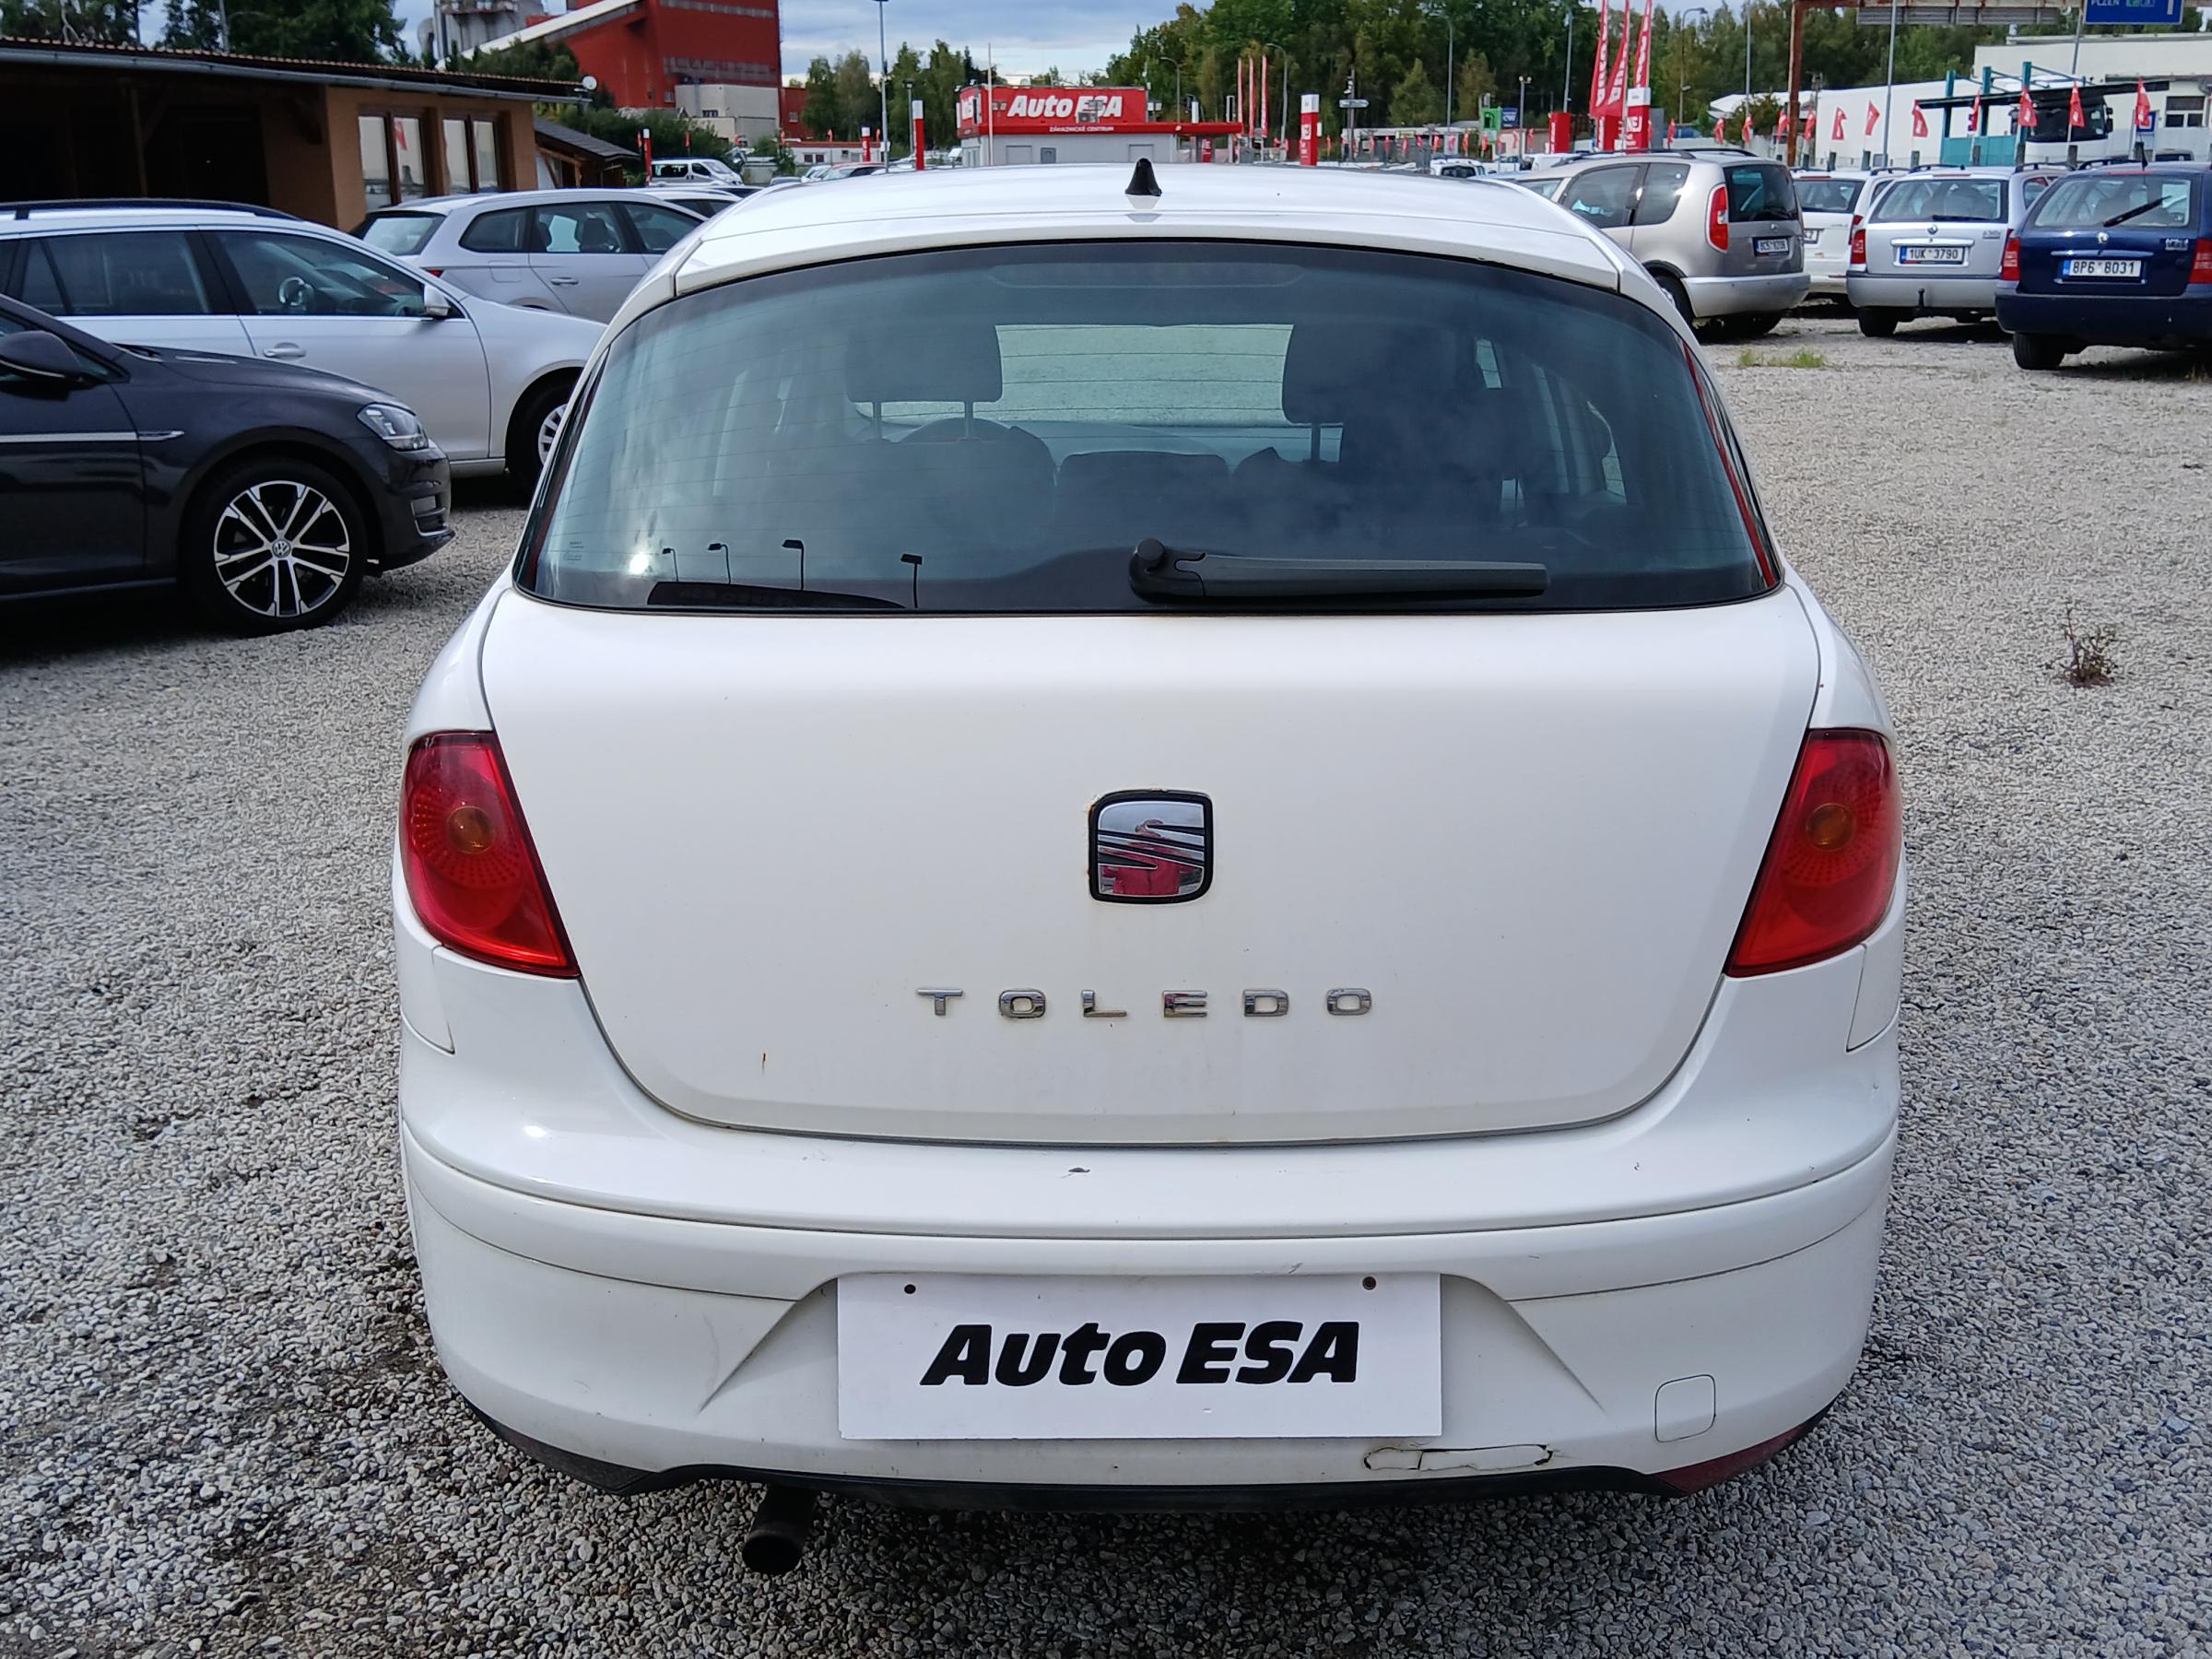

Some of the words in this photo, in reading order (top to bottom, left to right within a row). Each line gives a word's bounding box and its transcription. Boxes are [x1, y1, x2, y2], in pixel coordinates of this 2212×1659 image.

[1006, 95, 1073, 118] Auto
[1909, 249, 1925, 259] 1UK
[1934, 249, 1959, 259] 3790
[2072, 262, 2095, 274] 8P6
[2104, 262, 2135, 274] 8031
[916, 988, 1372, 1018] TOLEDO
[919, 1323, 1167, 1387] Auto
[1175, 1321, 1360, 1385] ESA
